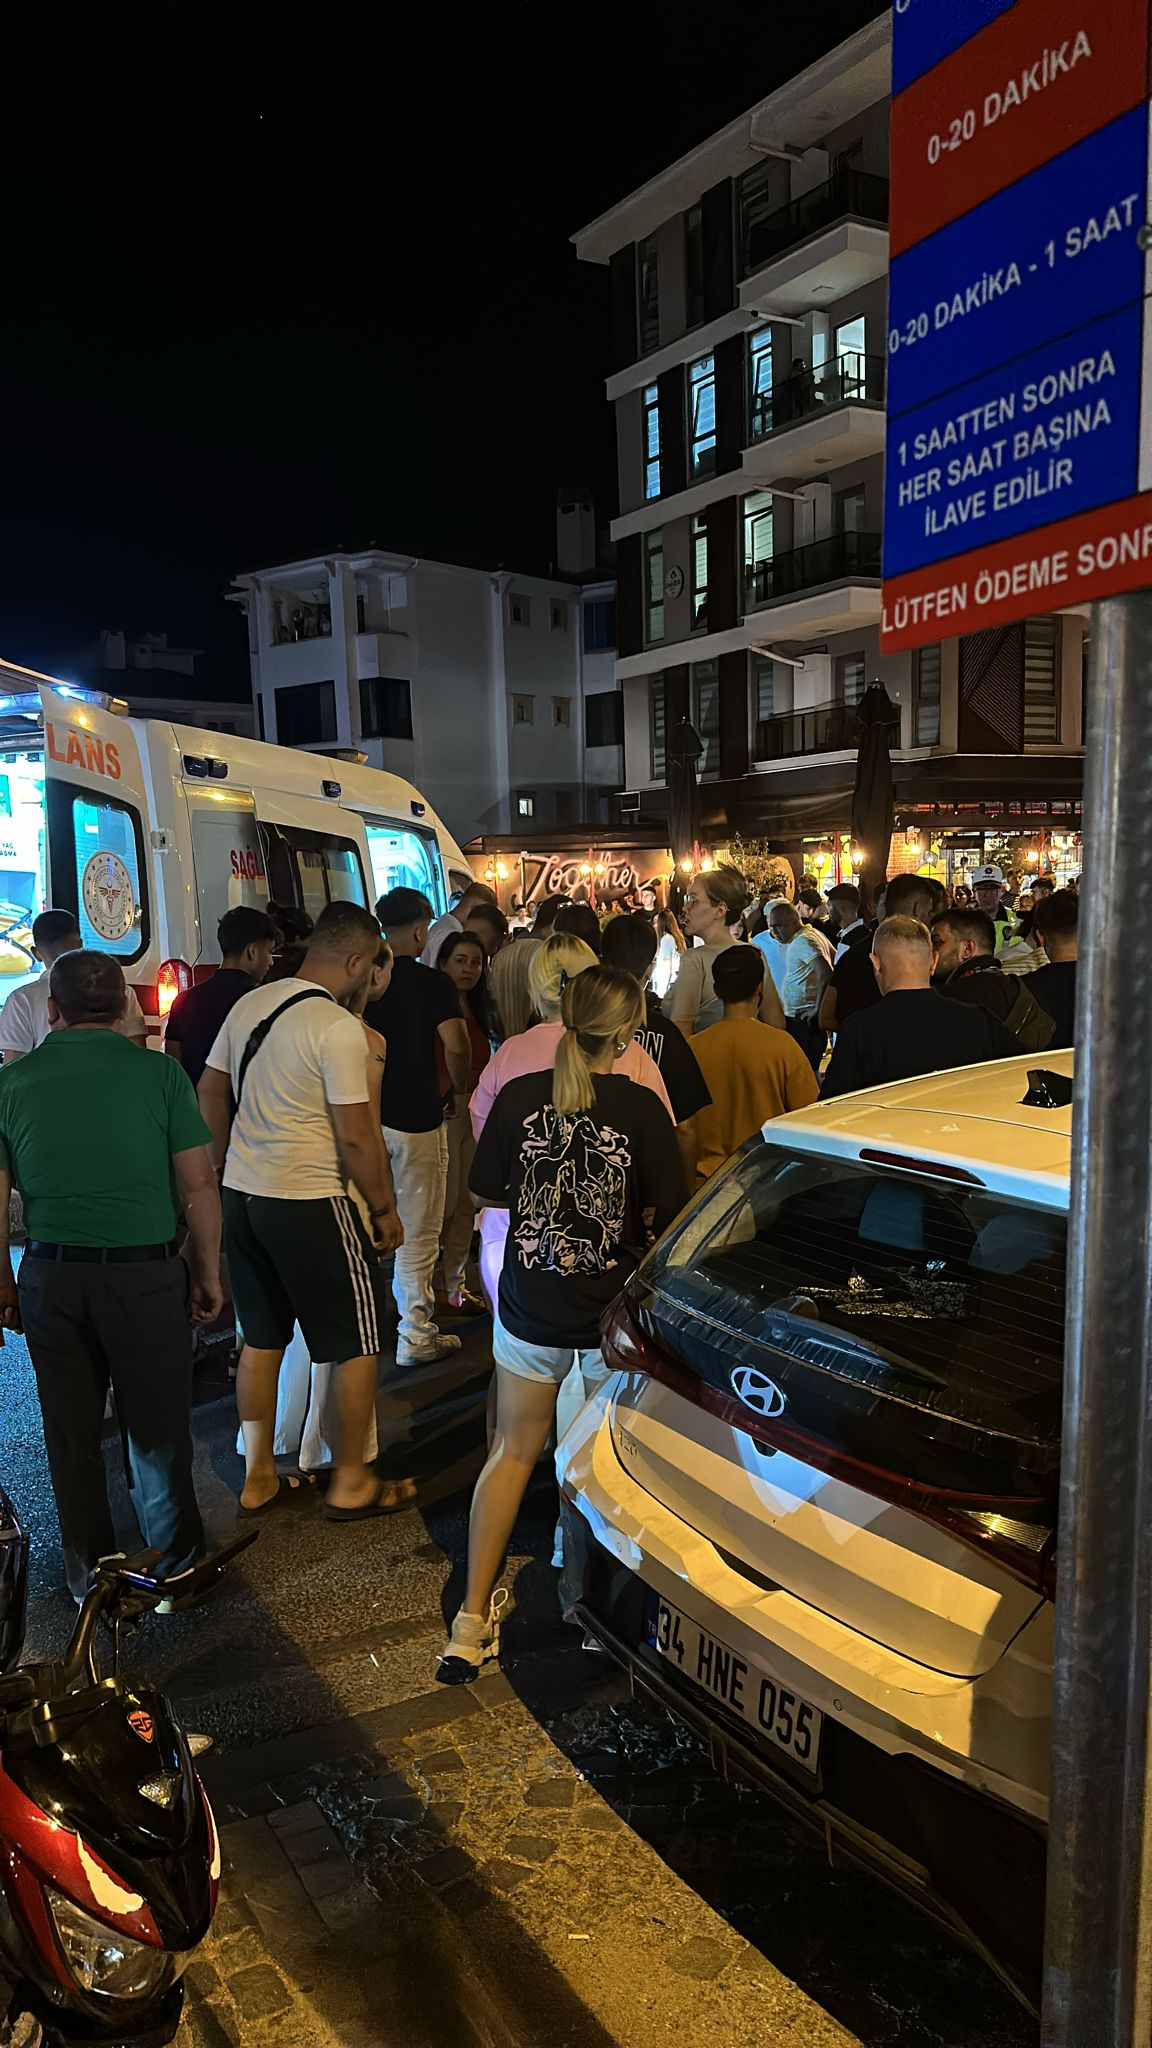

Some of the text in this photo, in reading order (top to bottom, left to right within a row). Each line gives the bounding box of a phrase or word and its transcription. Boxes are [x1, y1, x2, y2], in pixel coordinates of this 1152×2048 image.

[927, 30, 1092, 165] 0-20 DAKİKA
[888, 312, 929, 354] 0-20
[934, 262, 1022, 330] DAKİKA
[1044, 239, 1055, 268] 1
[1064, 193, 1139, 258] SAAT
[898, 349, 1116, 467] 1 SAATTEN SONRA
[899, 398, 1111, 507] HER SAAT BAŞINA
[924, 457, 1073, 537] İLAVE EDİLİR
[881, 581, 968, 634] LÜTFEN
[974, 550, 1069, 605] ÖDEME
[46, 722, 121, 779] LANS
[657, 1605, 813, 1759] 34 HNE 055
